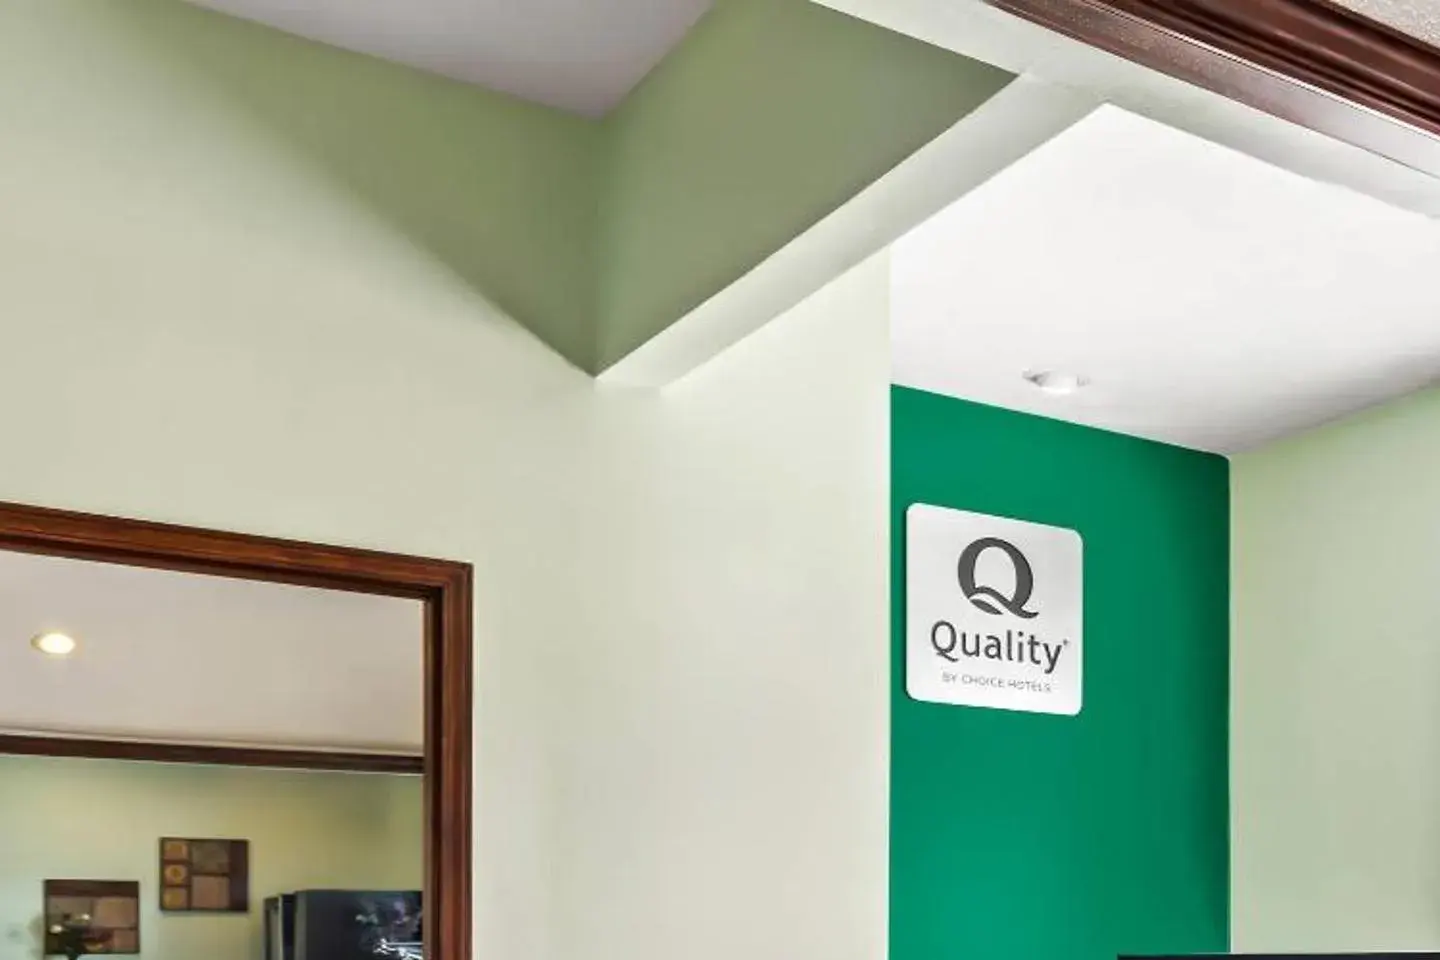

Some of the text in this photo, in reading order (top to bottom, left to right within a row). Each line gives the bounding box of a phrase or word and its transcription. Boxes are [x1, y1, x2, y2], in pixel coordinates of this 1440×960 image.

[957, 537, 1039, 619] Q
[931, 620, 1063, 674] Quality
[961, 674, 1004, 688] CHOICE
[1007, 680, 1051, 693] HOTELS
